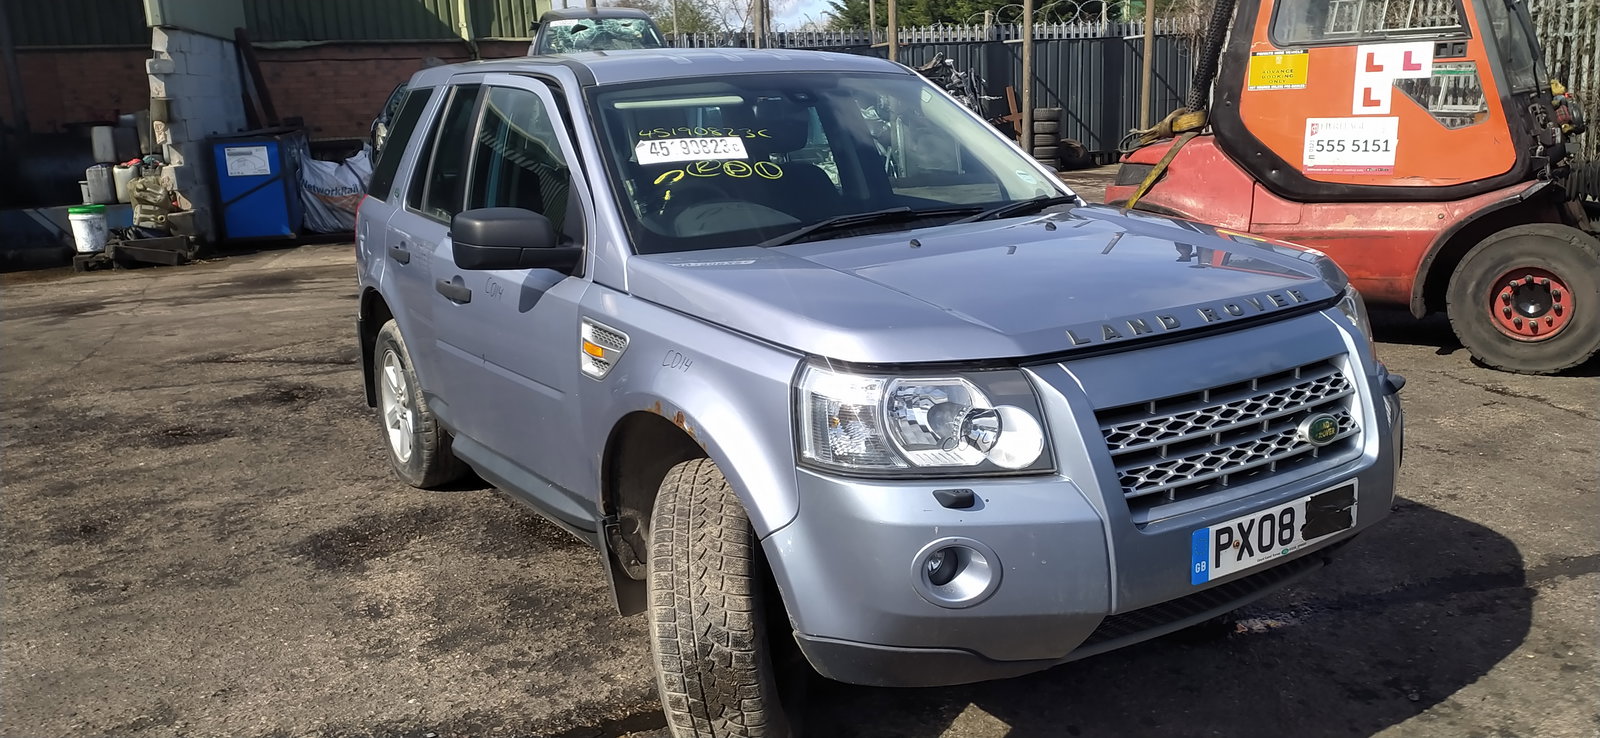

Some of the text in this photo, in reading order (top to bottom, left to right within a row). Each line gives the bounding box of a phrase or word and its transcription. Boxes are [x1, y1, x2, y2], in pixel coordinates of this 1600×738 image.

[1365, 51, 1421, 72] L L
[1362, 87, 1380, 107] L
[1316, 139, 1391, 153] 555 5151
[1065, 288, 1309, 346] LAND ROVER
[1214, 506, 1296, 568] PX08
[1195, 561, 1206, 573] GB
